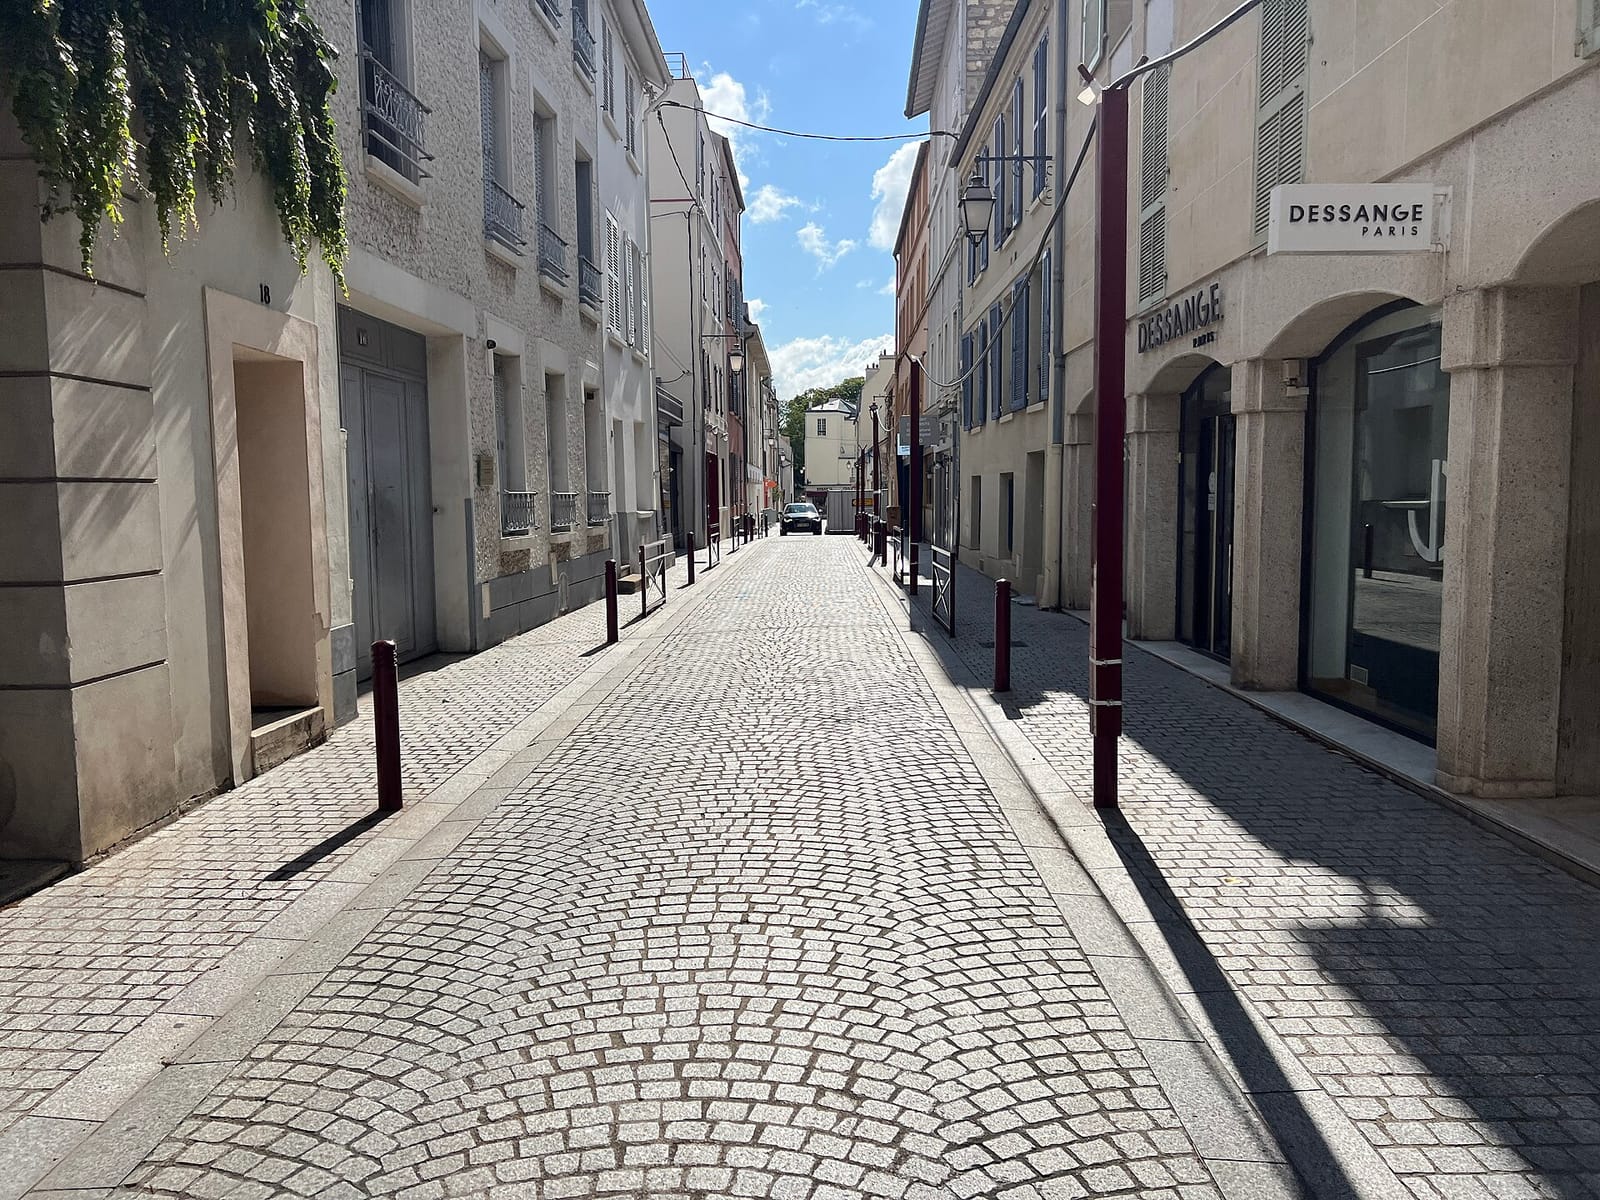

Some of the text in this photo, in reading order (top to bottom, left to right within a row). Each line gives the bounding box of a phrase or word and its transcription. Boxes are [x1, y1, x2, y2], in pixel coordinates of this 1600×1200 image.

[1289, 203, 1424, 223] DESSANGE
[1361, 225, 1418, 237] PARIS
[258, 282, 271, 305] 18
[1192, 331, 1215, 349] PARIS
